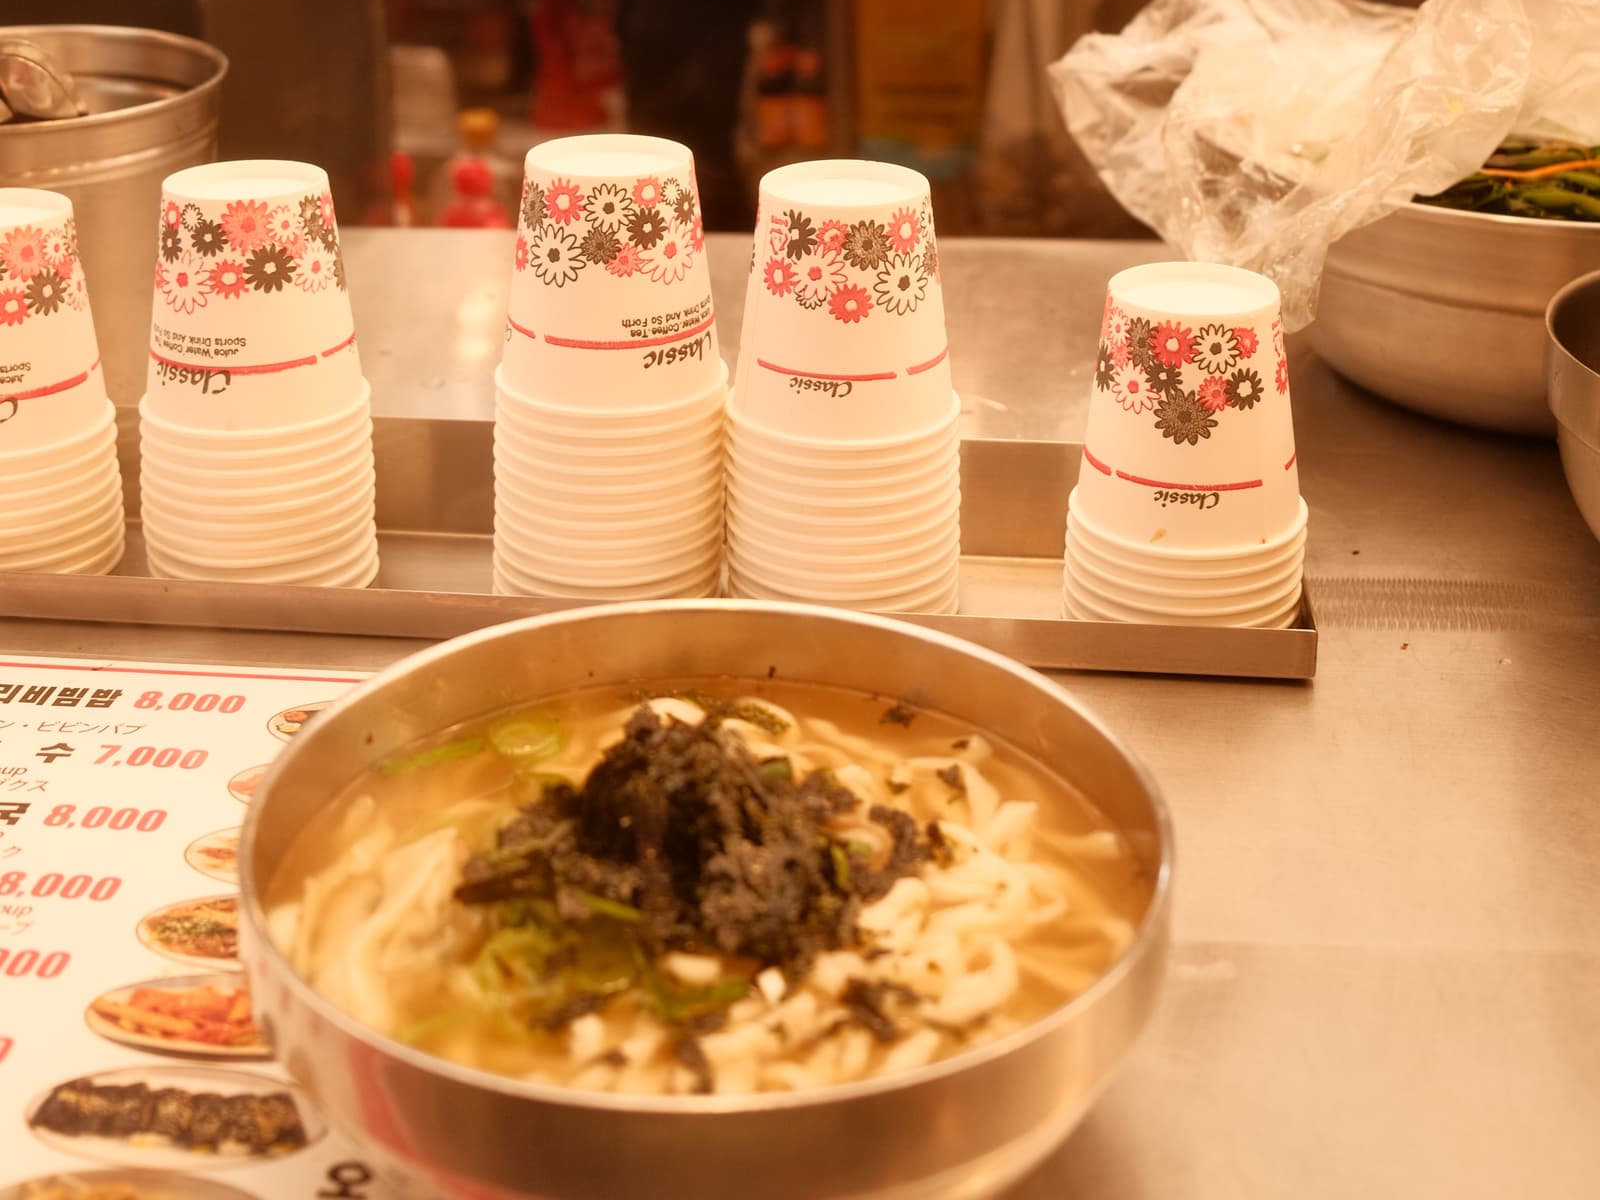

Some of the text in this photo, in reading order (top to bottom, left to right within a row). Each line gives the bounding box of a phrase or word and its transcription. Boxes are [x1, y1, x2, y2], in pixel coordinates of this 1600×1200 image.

[621, 317, 648, 328] Forth
[651, 314, 663, 325] So
[665, 310, 682, 320] And
[189, 336, 212, 347] Drink
[214, 337, 247, 347] Sports
[788, 377, 853, 398] Classic
[1153, 490, 1220, 510] Classic
[133, 690, 247, 714] 8,000
[35, 742, 209, 770] 수 7,000
[0, 767, 28, 778] up
[42, 804, 168, 833] 8,000
[0, 870, 123, 902] 8,000
